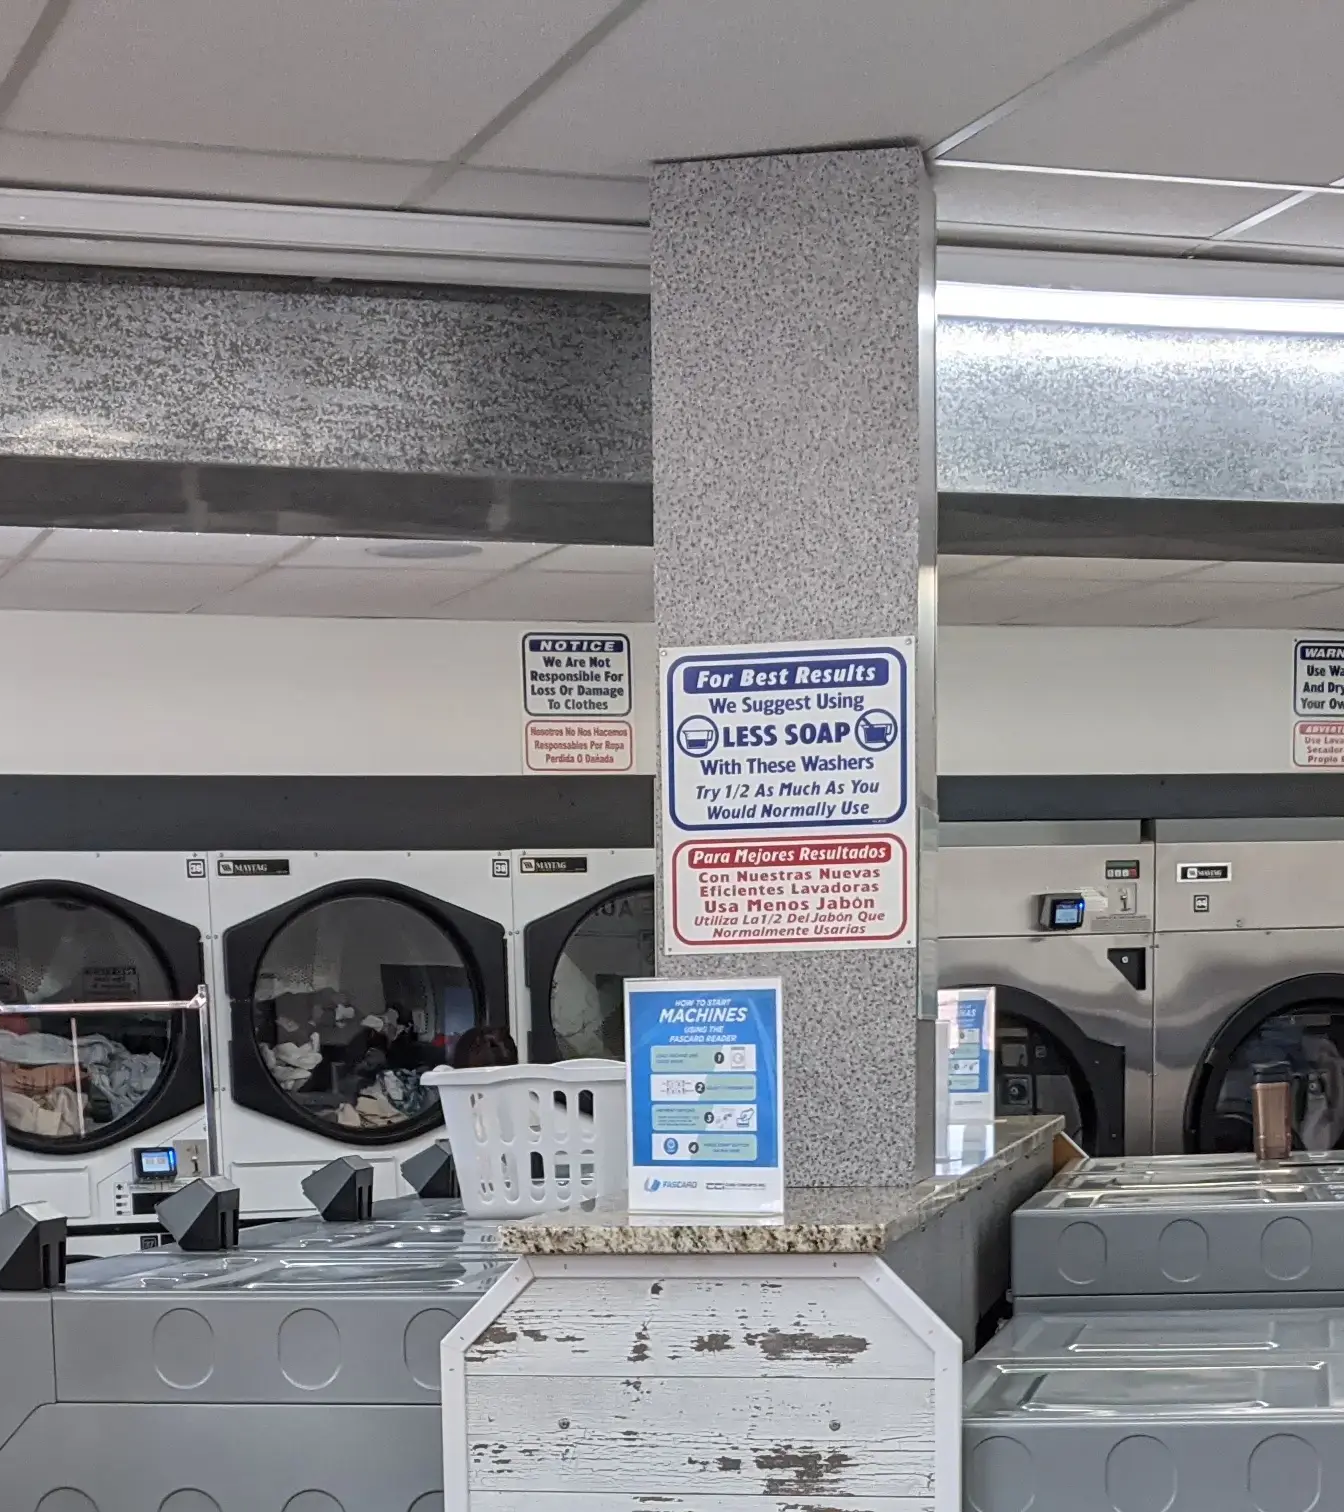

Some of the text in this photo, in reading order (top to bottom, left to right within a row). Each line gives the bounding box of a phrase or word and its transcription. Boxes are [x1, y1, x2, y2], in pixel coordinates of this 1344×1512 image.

[540, 640, 616, 652] NOTICE
[542, 655, 611, 668] We Are Not
[530, 670, 624, 684] Responsible For
[697, 663, 876, 689] For Best Results
[1306, 664, 1326, 677] Use
[531, 684, 624, 698] Loss Or Damage
[1303, 681, 1324, 694] And
[548, 699, 608, 710] To Clothes
[709, 693, 864, 716] We Suggest Using
[1301, 698, 1325, 710] Your
[723, 722, 851, 748] LESS SOAP
[700, 755, 874, 776] With These Washers
[696, 779, 880, 803] Try 1/2 As Much As You
[706, 802, 869, 821] Would Normally Use
[693, 845, 886, 866] Para Mejores Resultados
[234, 862, 268, 872] MAYTAG
[535, 860, 566, 870] MAYTAG
[699, 867, 880, 883] Con Nuestras Nuevas
[700, 882, 879, 898] Eficientes Lavadoras
[704, 896, 875, 913] Usa Menos Jabón
[694, 914, 738, 927] Utiliza
[787, 913, 810, 924] Del
[811, 912, 852, 923] Jabón
[858, 911, 885, 922] Que
[712, 926, 810, 939] Normalmente
[675, 998, 732, 1007] HOW TO START
[659, 1007, 748, 1023] MACHINES
[684, 1025, 724, 1034] USING THE
[669, 1034, 737, 1043] FASCARD READER
[662, 1180, 698, 1189] FASCARD
